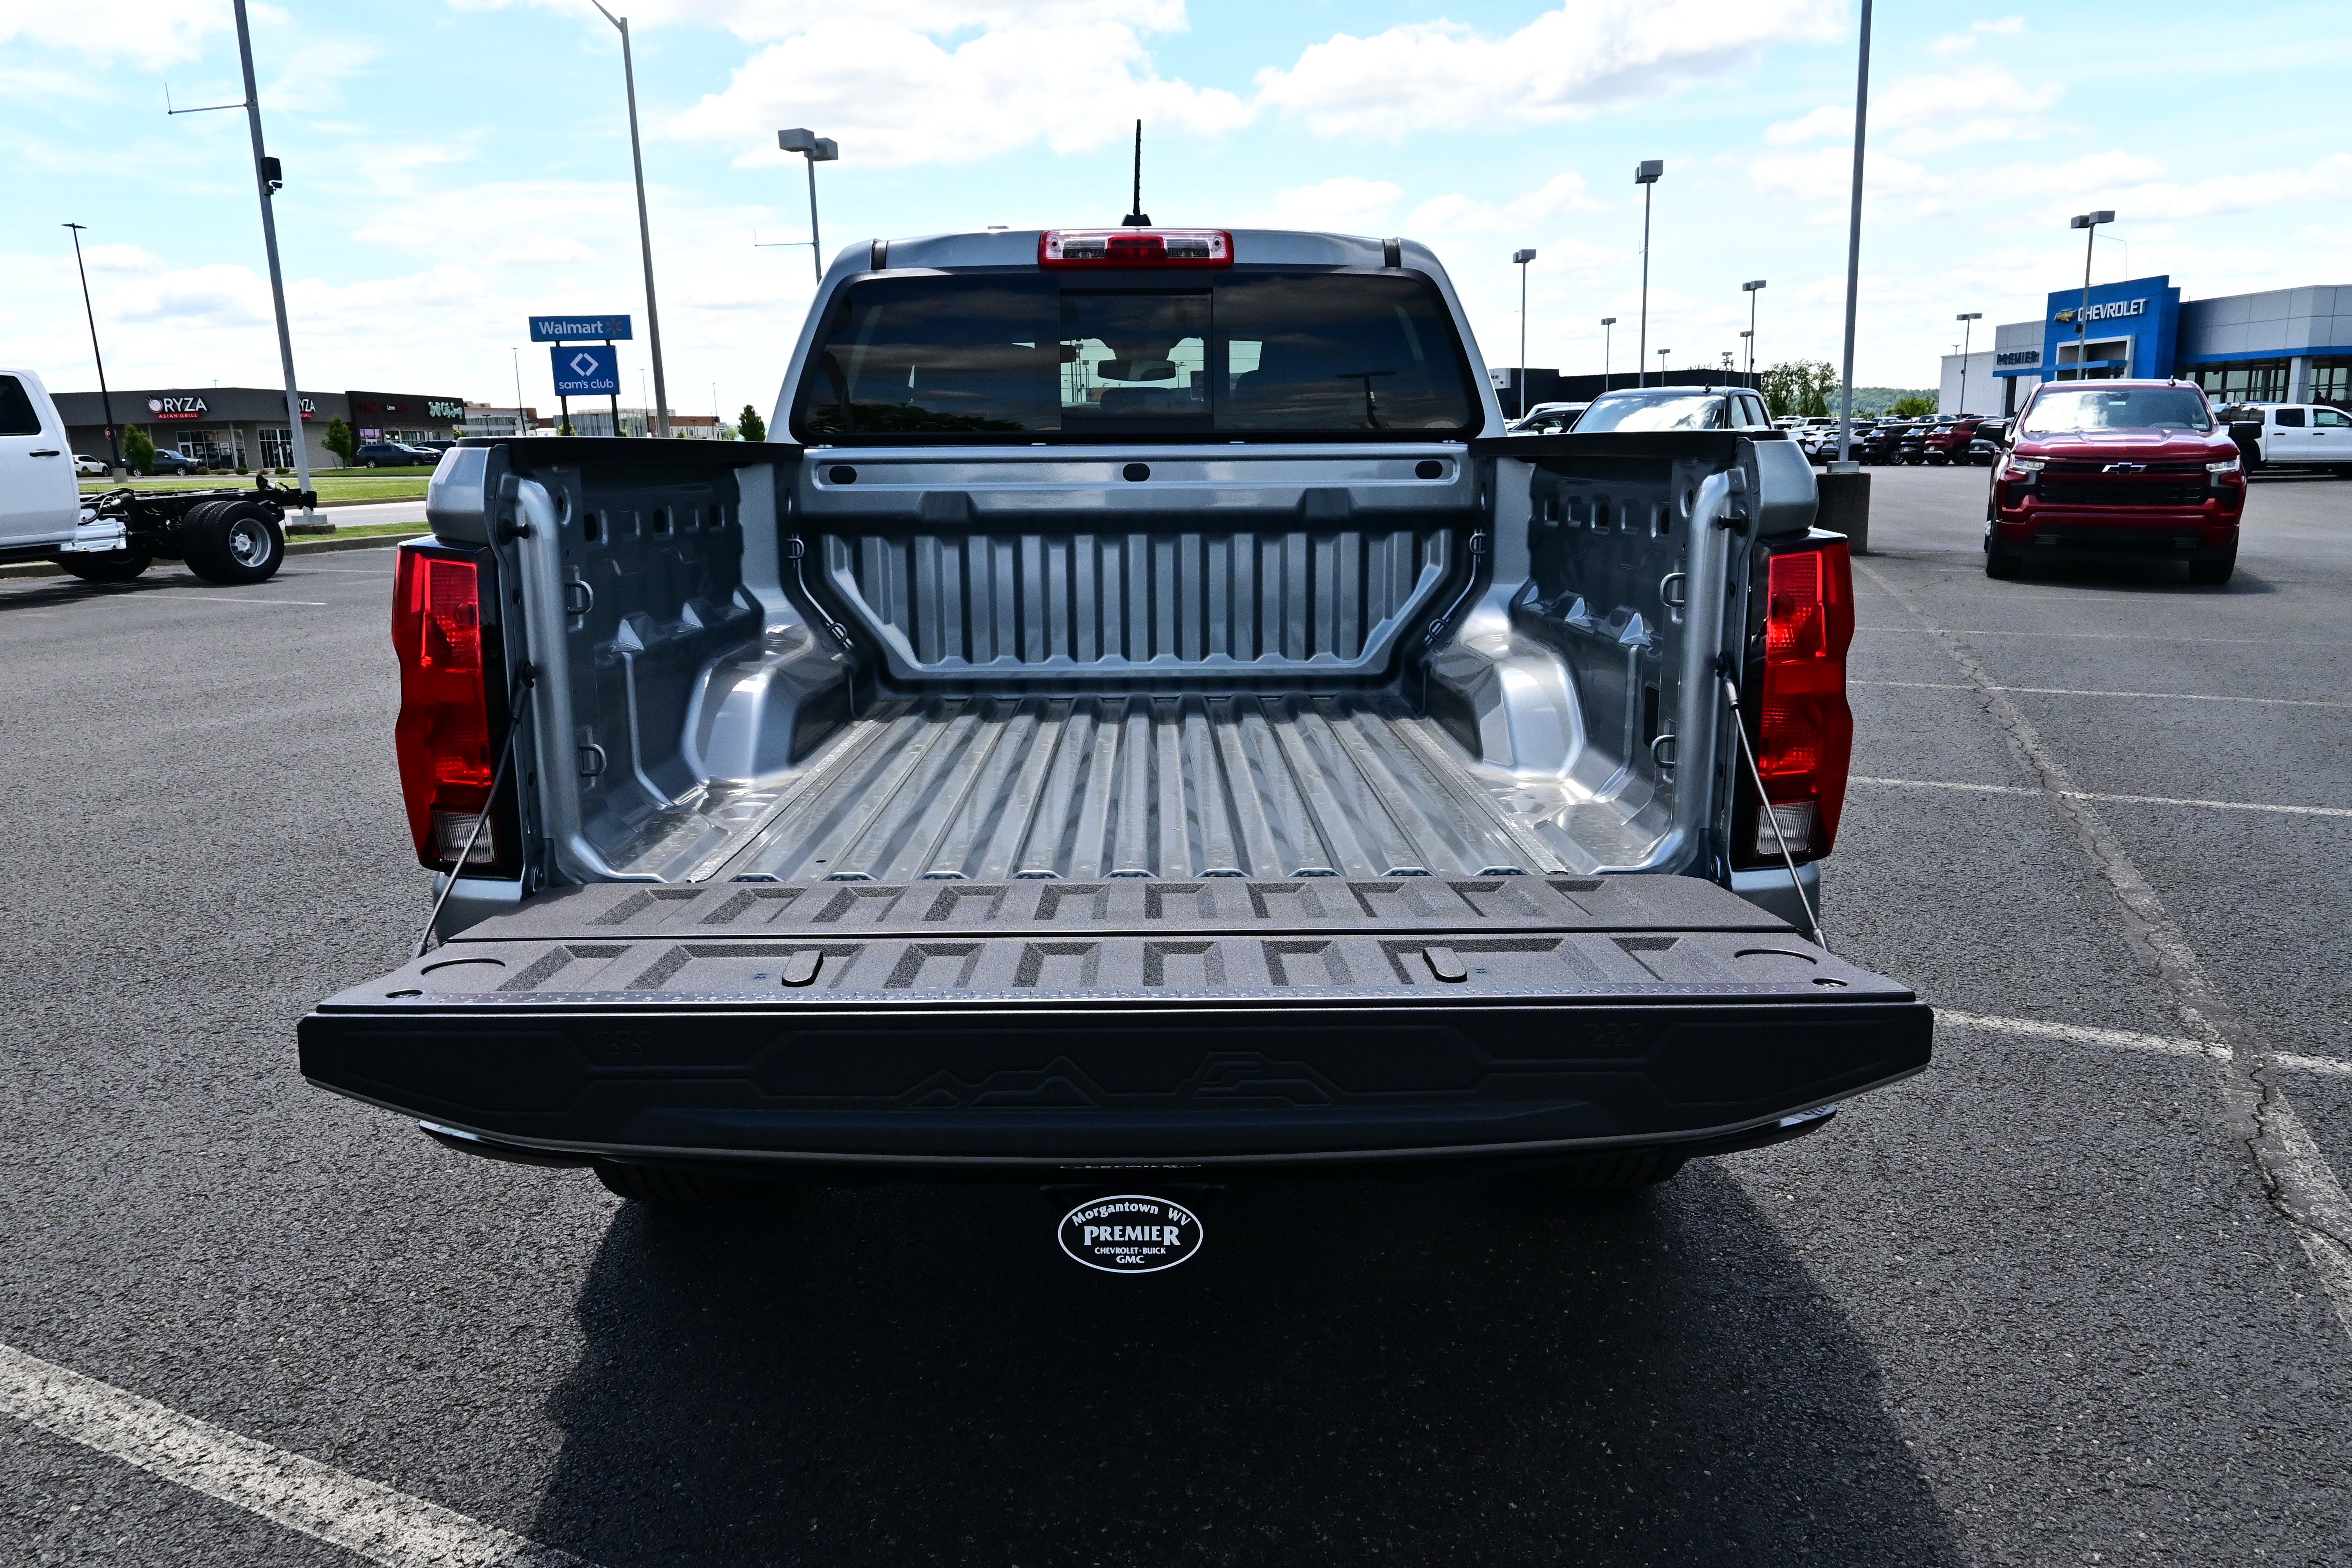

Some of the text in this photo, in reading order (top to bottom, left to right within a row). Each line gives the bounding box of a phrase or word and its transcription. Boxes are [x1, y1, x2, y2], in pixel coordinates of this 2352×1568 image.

[2078, 299, 2146, 321] CHEVROLET
[539, 321, 603, 335] Walmart
[559, 379, 614, 389] sam's club
[1072, 1202, 1191, 1226] Morgantown WV
[1084, 1226, 1181, 1245] PREMIER
[1116, 1255, 1145, 1263] GMC
